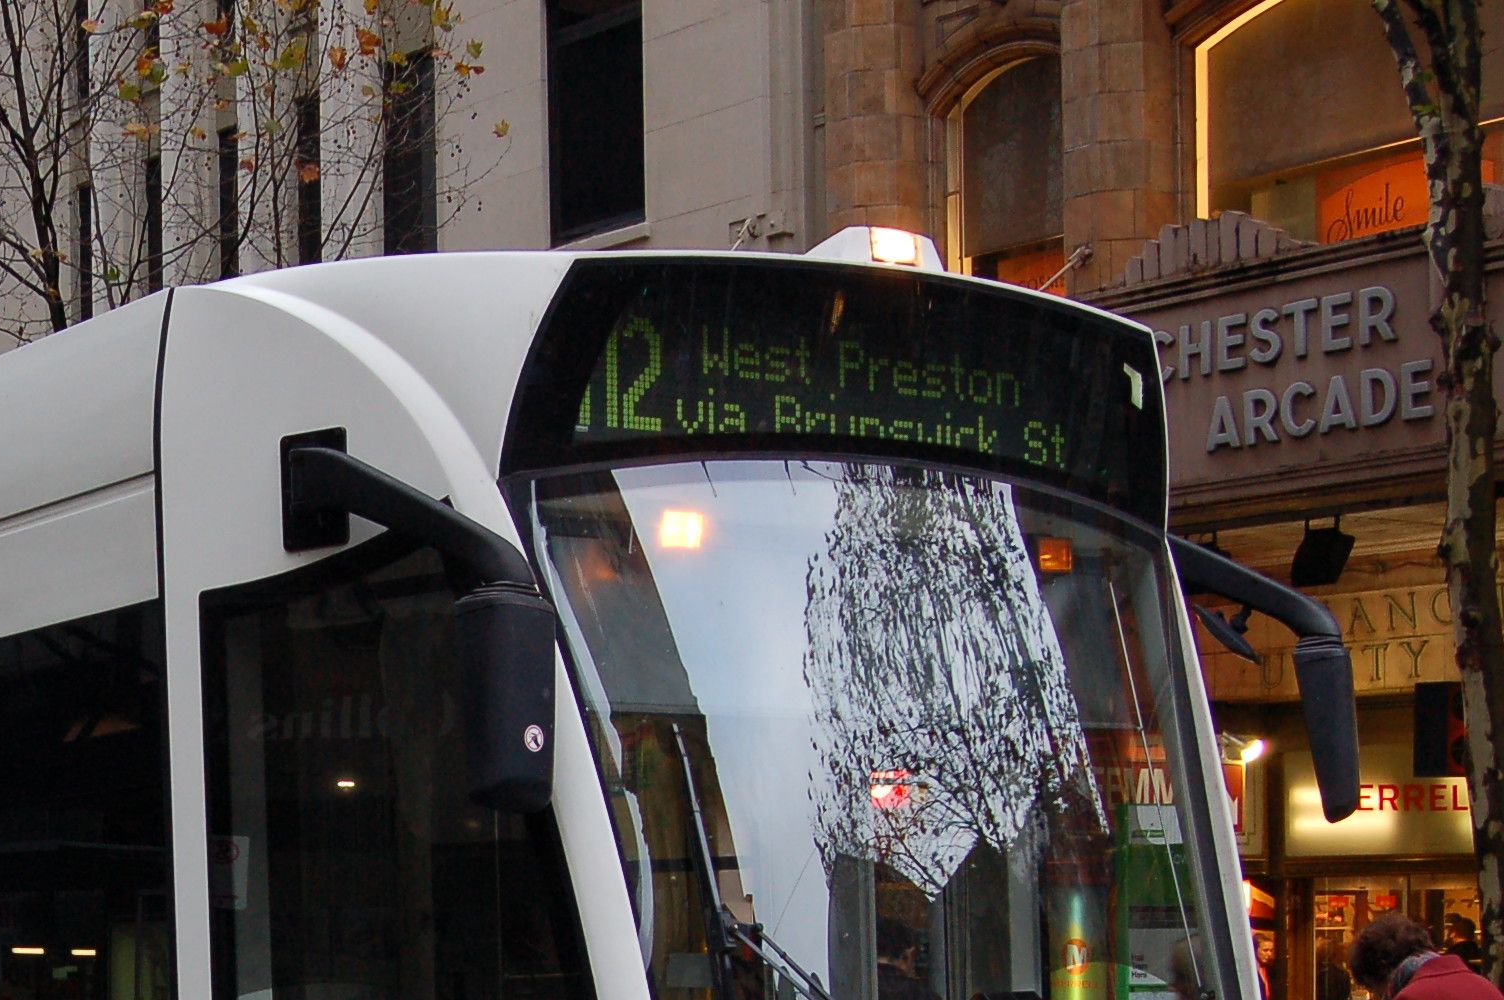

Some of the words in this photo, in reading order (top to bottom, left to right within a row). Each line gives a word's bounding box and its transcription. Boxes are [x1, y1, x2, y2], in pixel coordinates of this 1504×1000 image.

[1326, 183, 1405, 242] Smile
[703, 324, 809, 385] West
[839, 341, 1021, 408] Preston
[1154, 286, 1398, 383] CHESTER
[676, 388, 745, 434] via
[1024, 421, 1065, 470] St
[1207, 359, 1435, 453] ARCADE
[1358, 785, 1469, 811] ERREL
